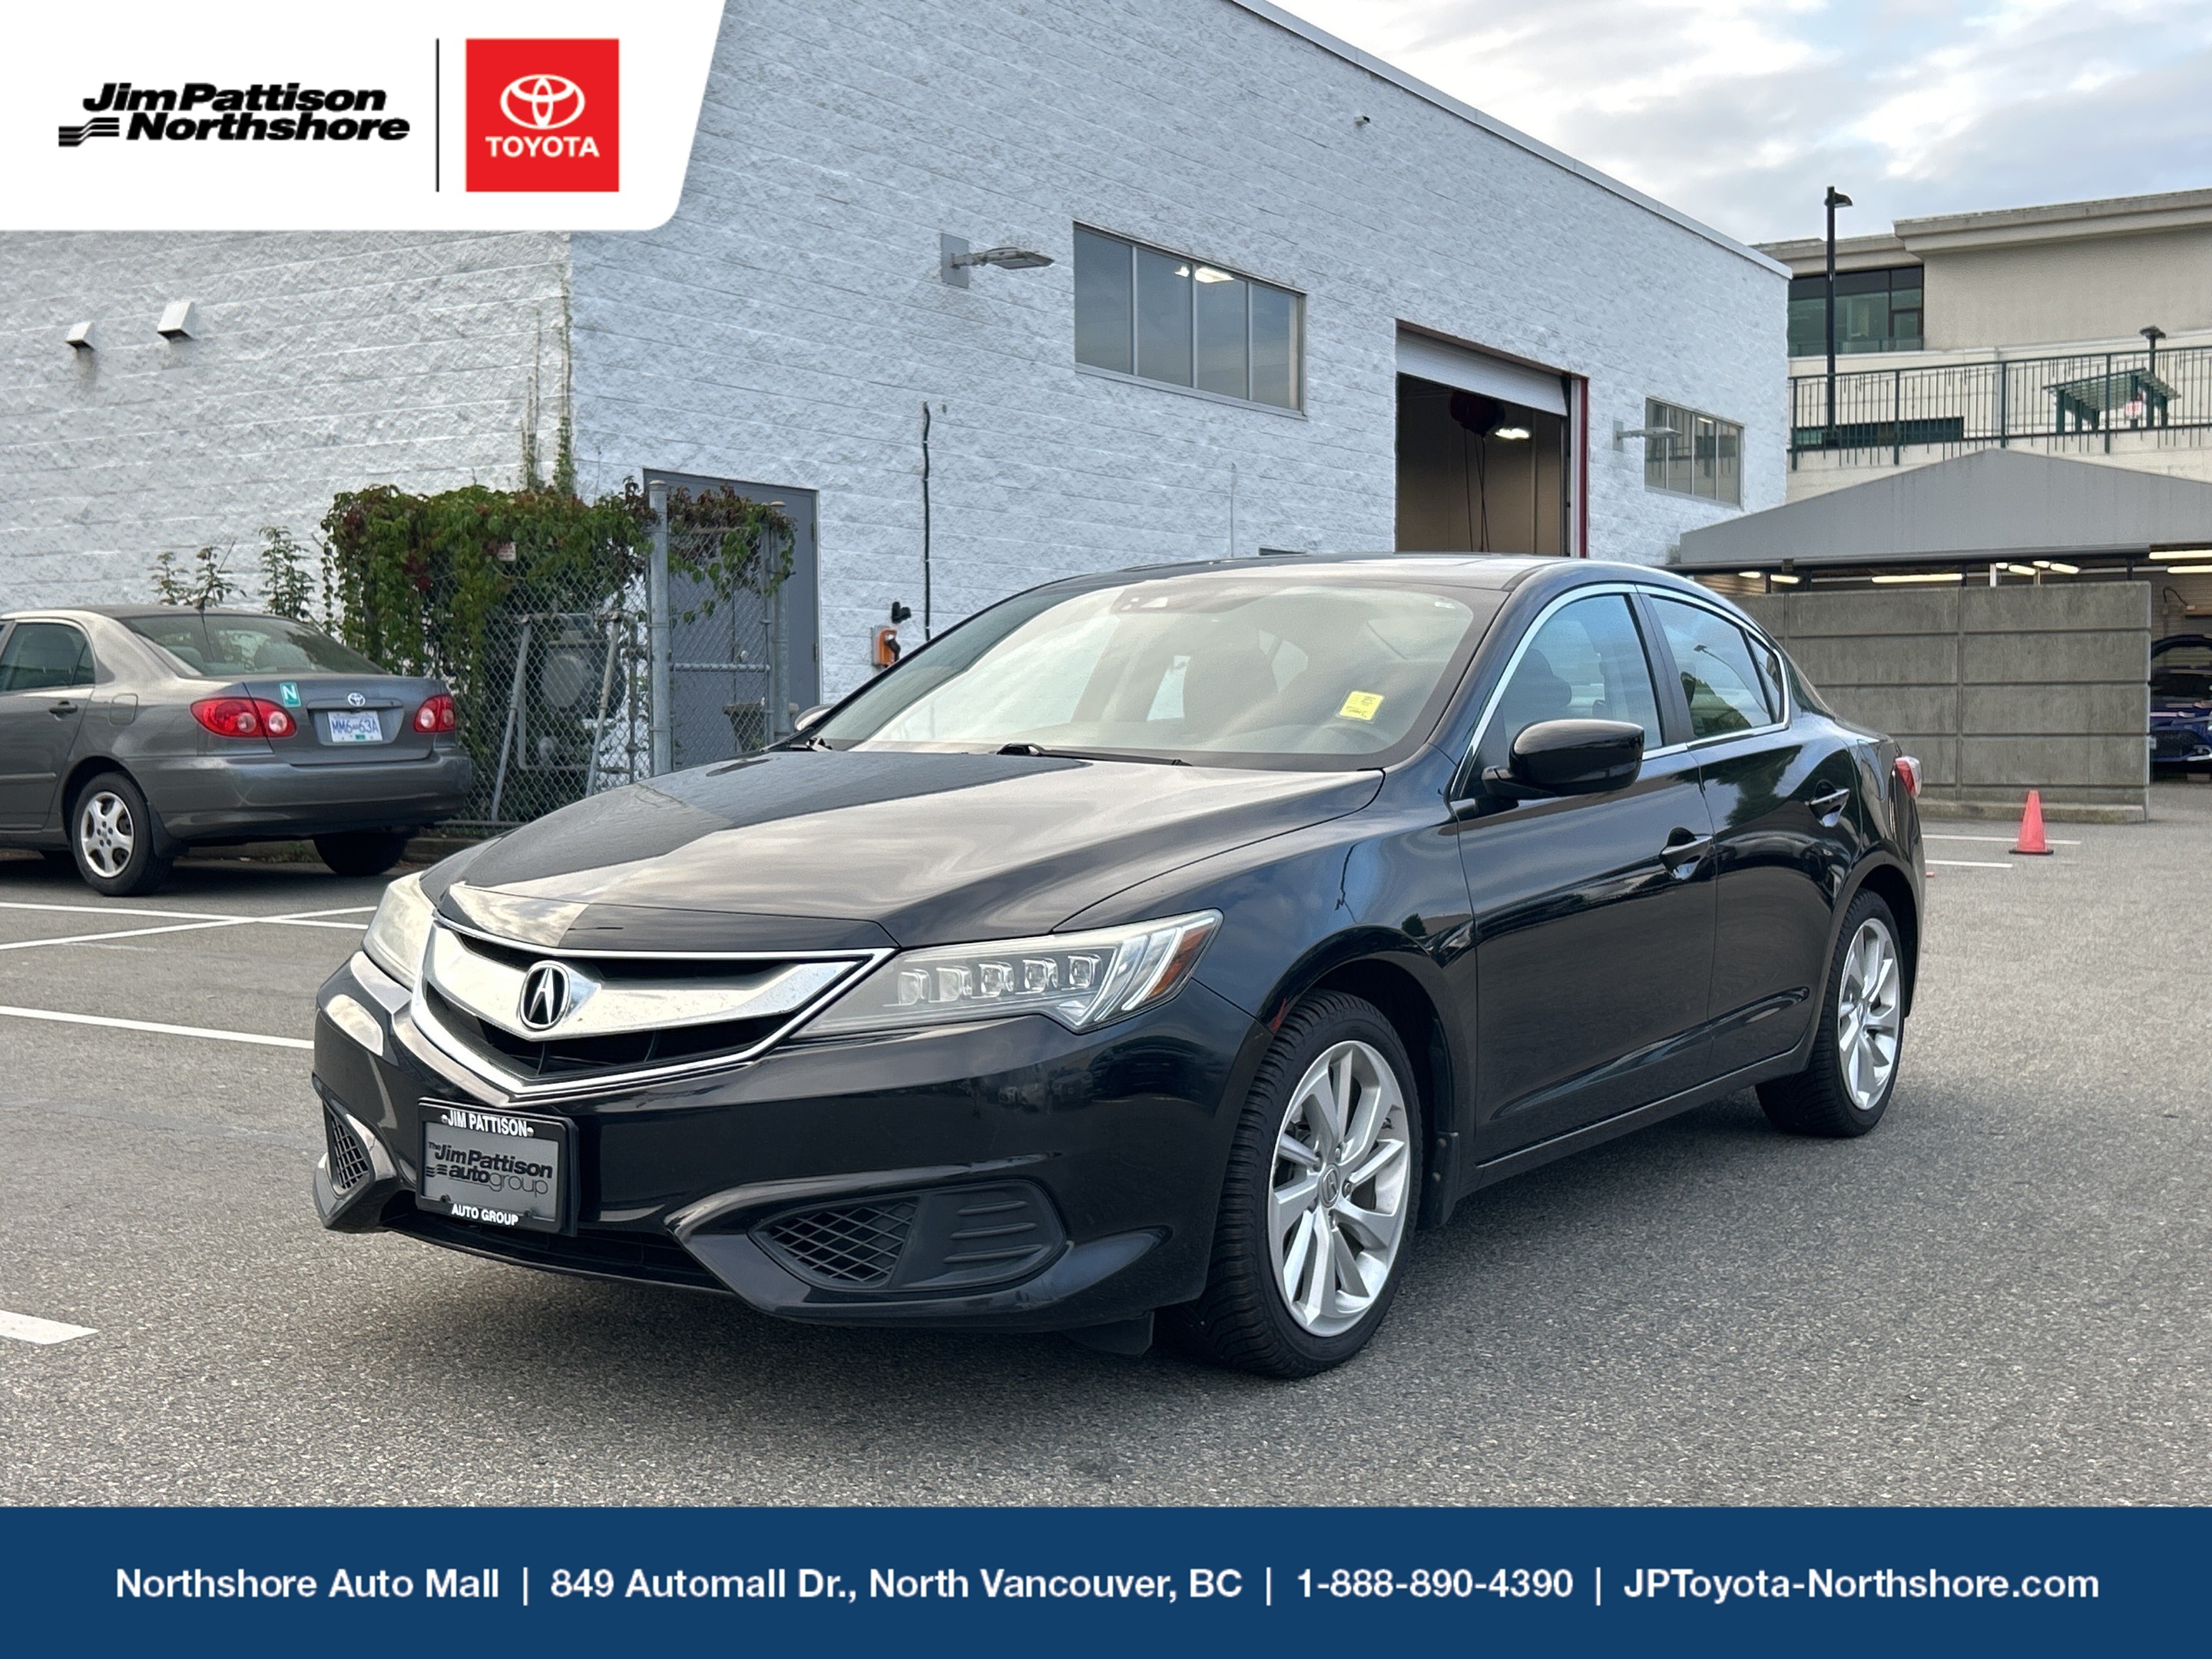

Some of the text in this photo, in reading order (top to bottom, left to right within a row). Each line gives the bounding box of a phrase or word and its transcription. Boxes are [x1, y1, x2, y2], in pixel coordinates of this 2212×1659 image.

[282, 685, 297, 700] N
[447, 1110, 528, 1137] JIM PATTISON
[435, 1144, 553, 1179] Jim Pattison
[452, 1204, 519, 1226] AUTO GROUP
